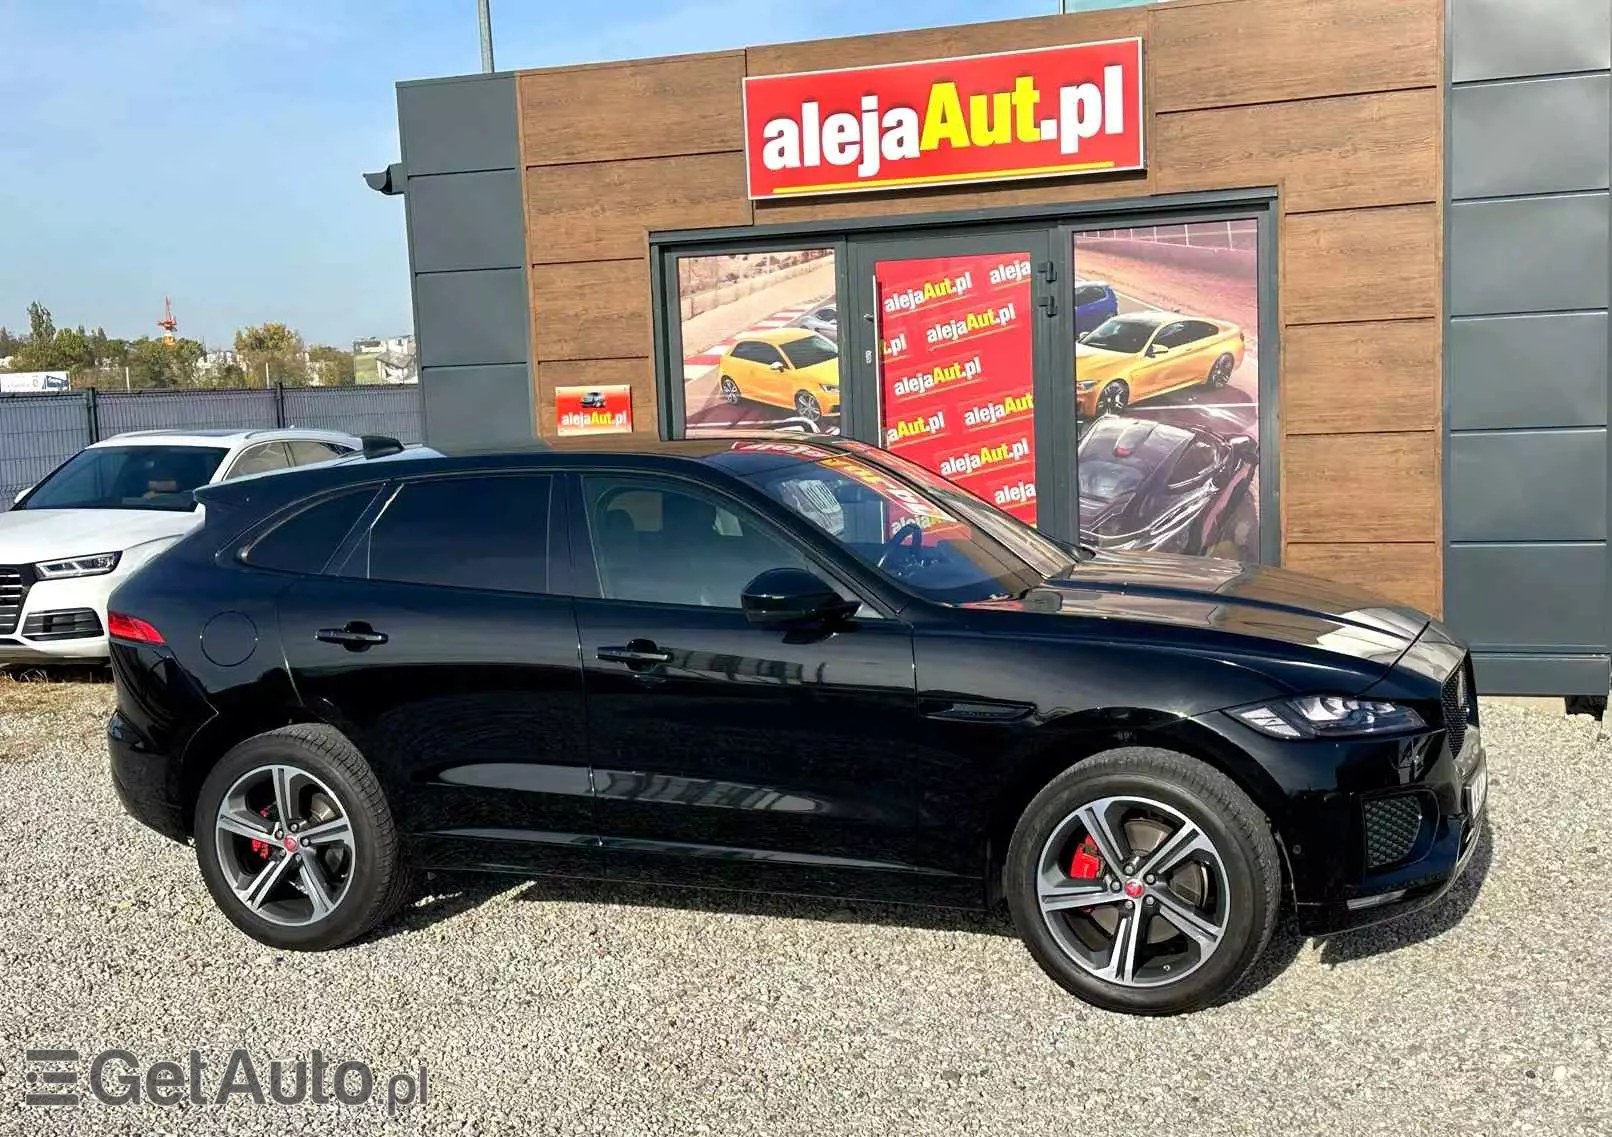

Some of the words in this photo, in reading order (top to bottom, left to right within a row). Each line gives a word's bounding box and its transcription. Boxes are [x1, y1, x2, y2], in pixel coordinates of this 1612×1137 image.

[762, 64, 1123, 177] alejaAut.pl
[885, 272, 973, 313] alejaAut.pl
[926, 302, 1016, 344] alejaAut.pl
[894, 355, 982, 396] alejaAut.pl
[561, 411, 627, 427] alejaAut.pl
[939, 437, 1029, 476] alejaAut.pl
